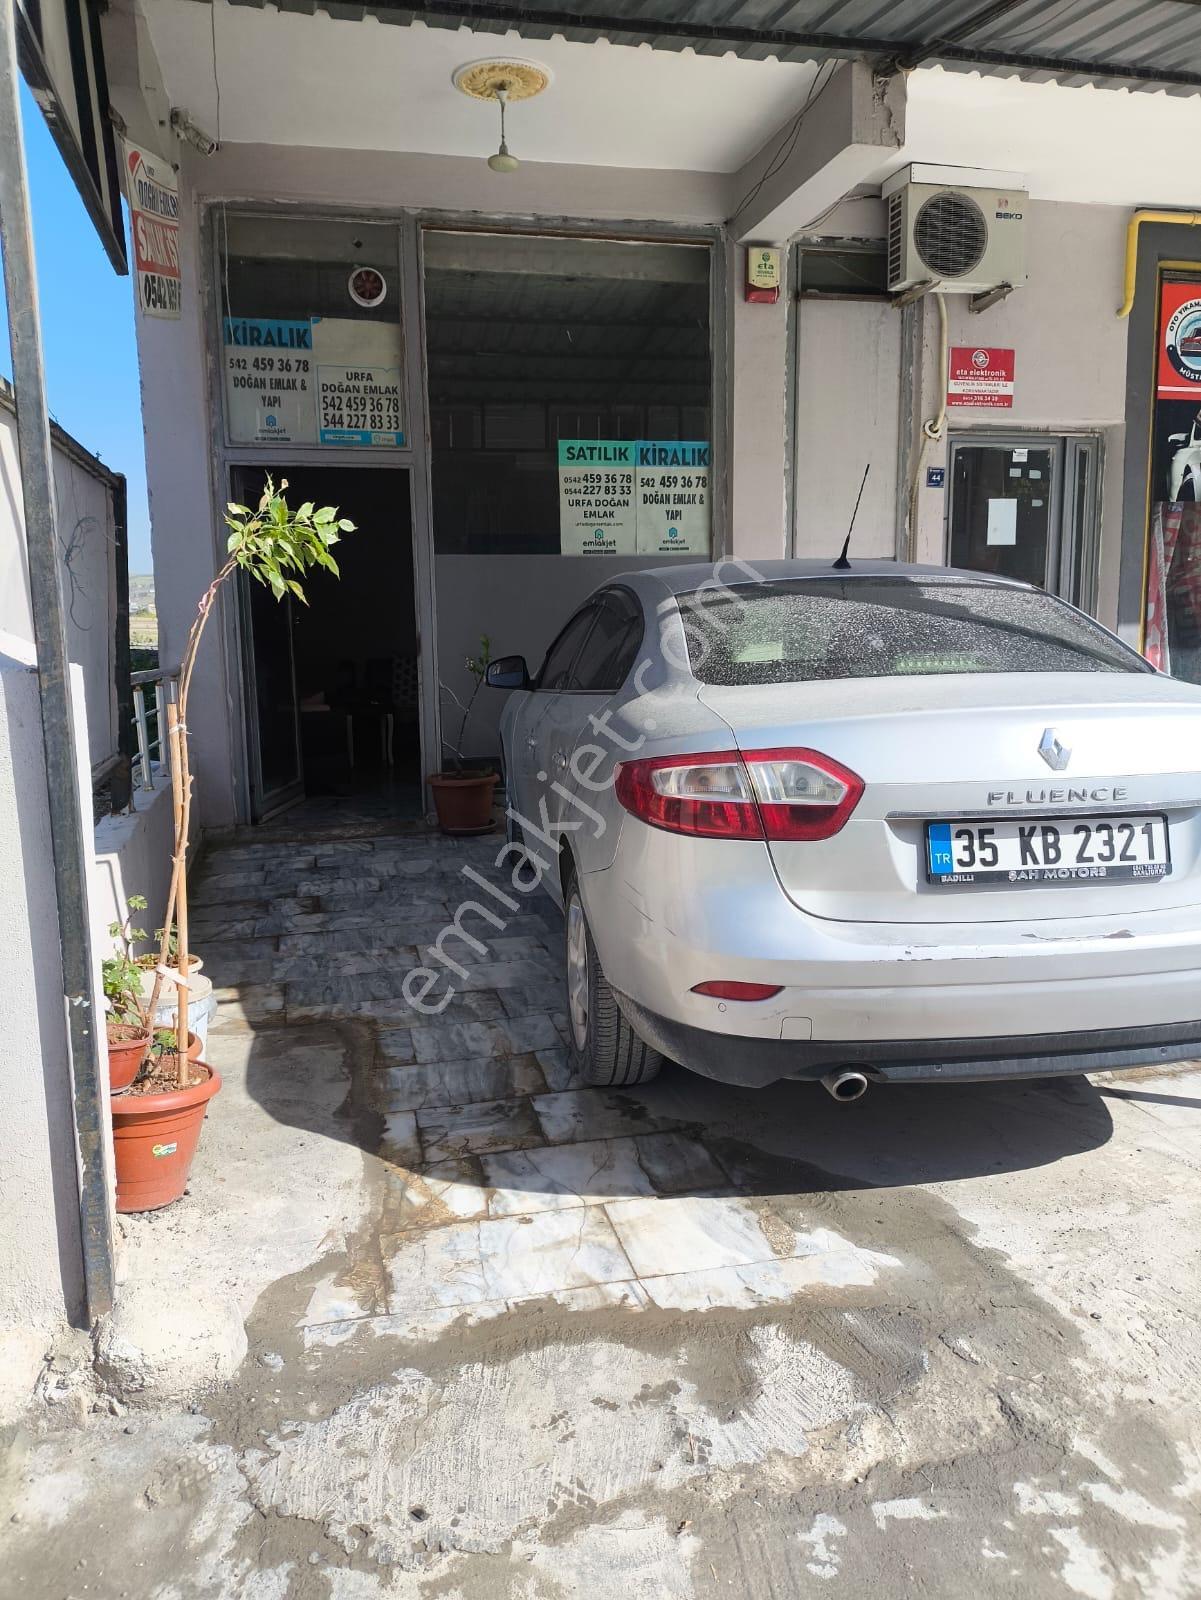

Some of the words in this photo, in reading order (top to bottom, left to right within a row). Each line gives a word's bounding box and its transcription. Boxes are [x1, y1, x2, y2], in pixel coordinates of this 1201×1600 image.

[996, 212, 1023, 220] BEKO
[1178, 301, 1201, 315] YIKAM
[1169, 315, 1179, 332] OTO
[227, 321, 309, 348] KİRALIK
[229, 358, 247, 370] 542
[252, 357, 275, 372] 459
[277, 358, 291, 373] 36
[294, 359, 309, 373] 78
[346, 371, 374, 382] URFA
[969, 369, 1007, 377] elektronik
[1179, 367, 1201, 380] MÜST
[233, 373, 267, 390] DOĞAN
[269, 377, 298, 391] EMLAK
[300, 378, 307, 391] &
[322, 381, 360, 395] DOĞAN
[363, 385, 398, 395] EMLAK
[261, 394, 282, 409] YAPI
[322, 395, 342, 411] 542
[346, 396, 367, 411] 459
[369, 397, 383, 412] 36
[386, 397, 400, 413] 78
[323, 412, 344, 428] 544
[347, 413, 367, 429] 227
[370, 414, 384, 430] 83
[387, 415, 400, 430] 33
[566, 446, 630, 462] SATILIK
[639, 443, 710, 466] KİRALIK
[563, 476, 582, 484] 0542
[582, 473, 602, 484] 459
[605, 474, 617, 484] 36
[619, 474, 632, 484] 78
[640, 477, 655, 488] 542
[659, 476, 678, 488] 459
[681, 476, 693, 488] 36
[695, 476, 707, 488] 78
[583, 485, 601, 495] 227
[604, 485, 616, 495] 83
[619, 485, 631, 495] 33
[568, 499, 592, 507] URFA
[595, 498, 629, 507] DOĞAN
[643, 491, 670, 505] DOĞAN
[672, 493, 697, 505] EMLAK
[698, 493, 705, 505] &
[583, 510, 615, 519] EMLAK
[665, 509, 682, 521] YAPI
[582, 539, 617, 548] emlakjet
[662, 538, 686, 546] emlakjet
[986, 786, 1129, 806] FLUENCE
[935, 853, 951, 865] TR
[955, 828, 999, 868] 35
[1018, 825, 1062, 866] KB
[1073, 823, 1155, 864] 2321
[1043, 866, 1107, 880] MOTORS
